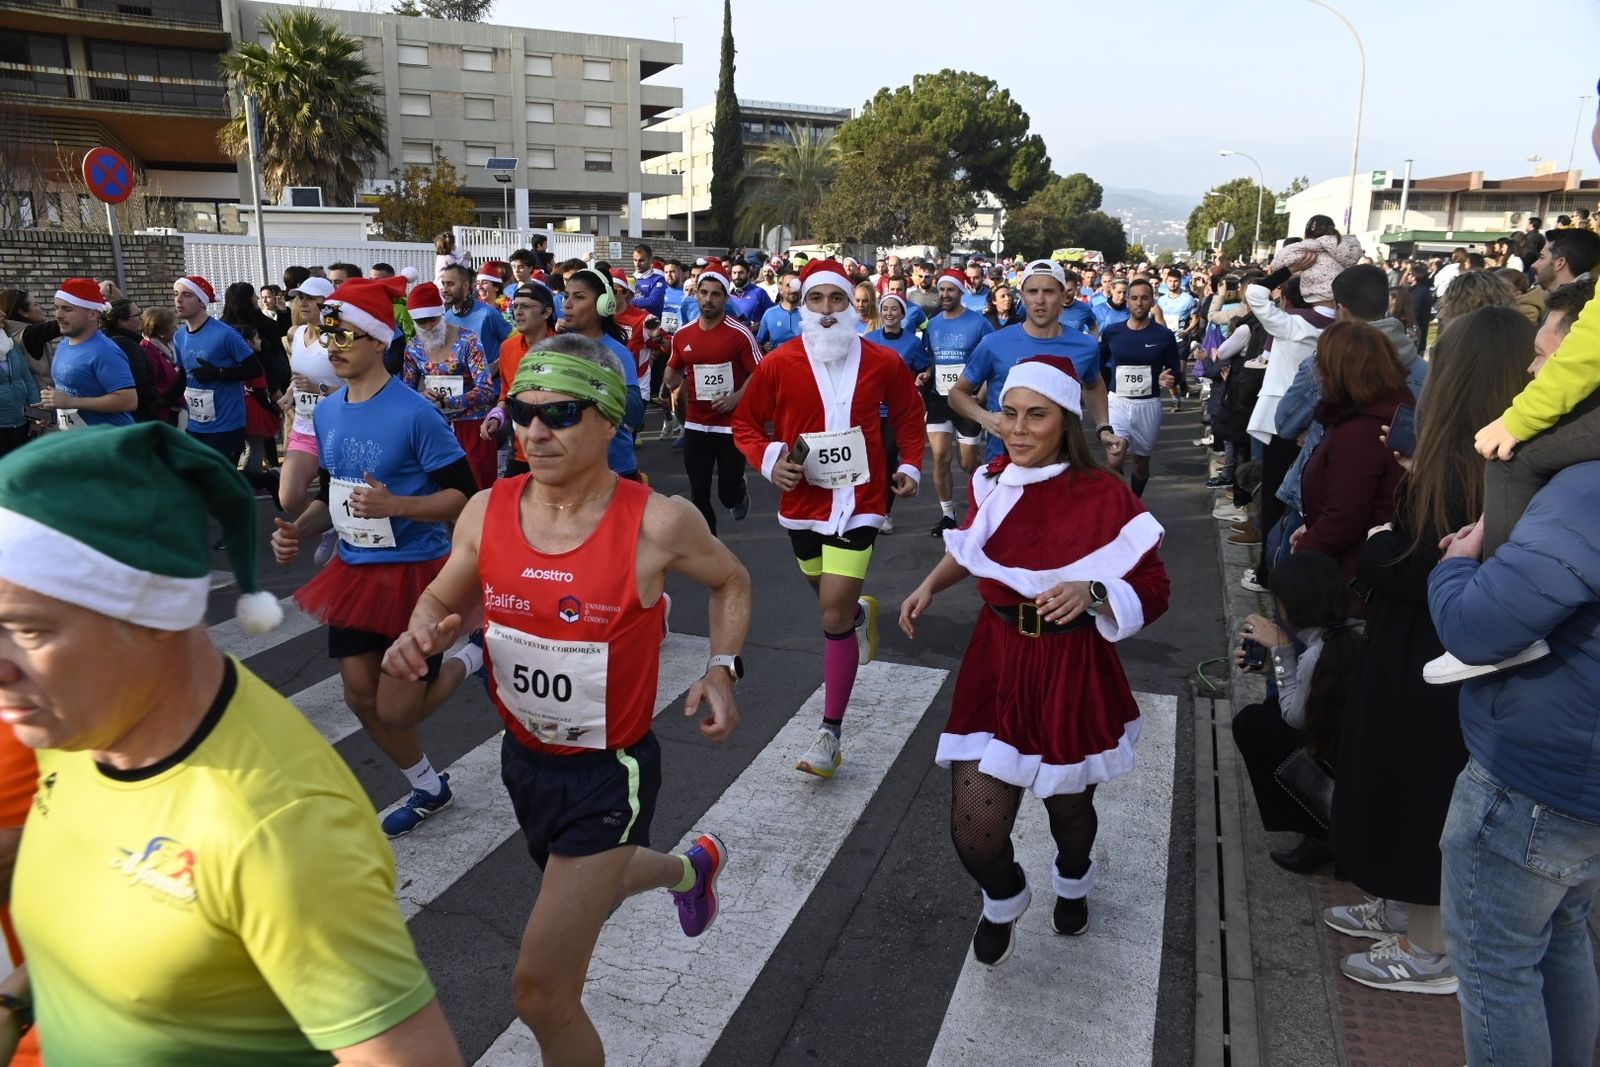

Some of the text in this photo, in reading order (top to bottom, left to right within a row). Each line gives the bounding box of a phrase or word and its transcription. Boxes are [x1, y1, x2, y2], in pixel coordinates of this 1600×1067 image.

[704, 374, 724, 386] 225
[941, 373, 958, 382] 759
[1124, 374, 1144, 383] 786
[300, 394, 319, 405] 417
[818, 446, 852, 464] 550
[551, 645, 601, 654] CORDOBESA
[513, 663, 572, 703] 500
